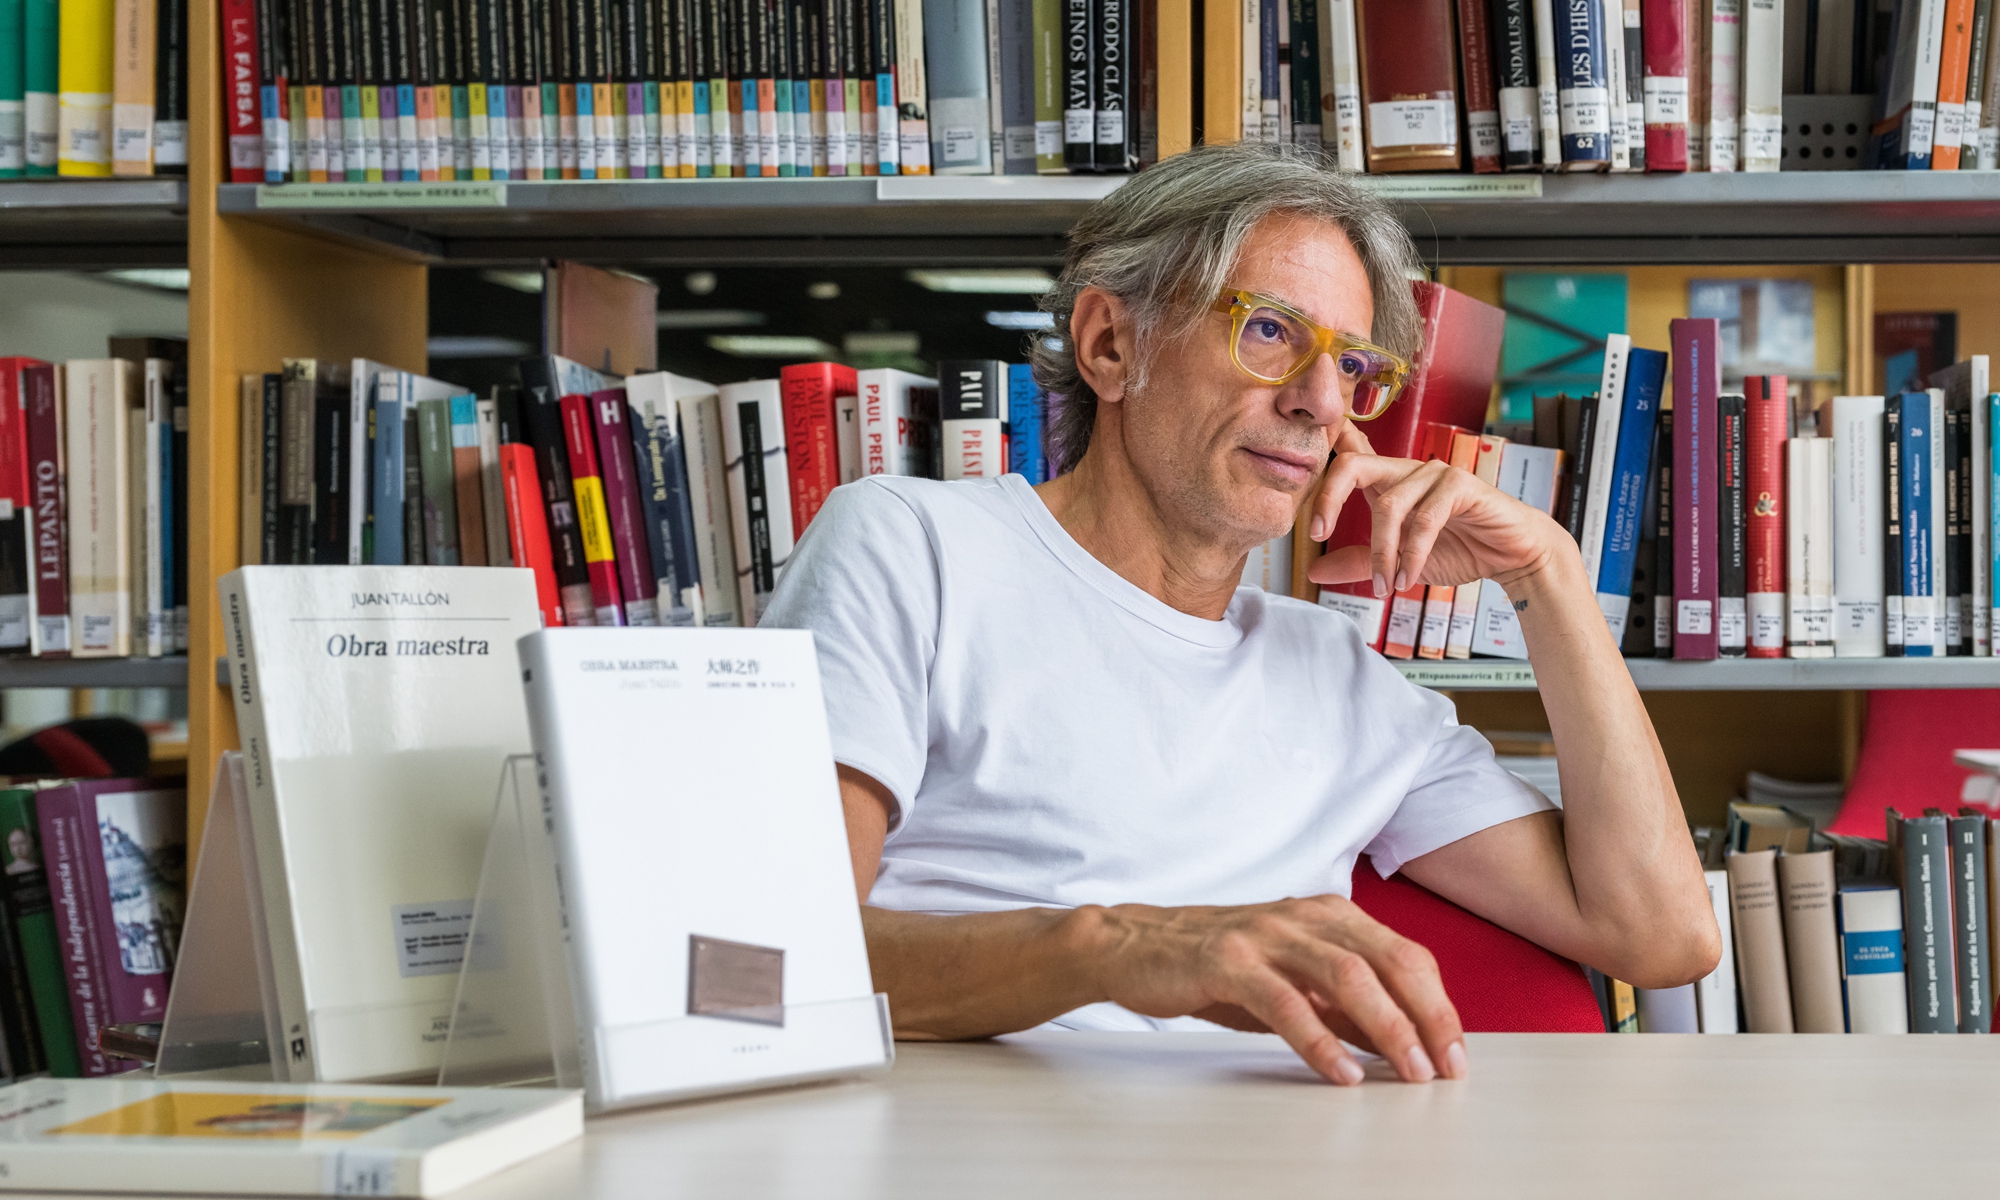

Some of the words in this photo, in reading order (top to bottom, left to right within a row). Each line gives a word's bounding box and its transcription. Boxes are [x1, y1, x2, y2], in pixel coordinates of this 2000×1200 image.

[232, 18, 248, 46] LA
[1507, 16, 1525, 88] ANDALUS
[233, 52, 254, 128] FARSA
[1577, 138, 1594, 149] 62
[1689, 339, 1699, 394] MESOAMÉRICA
[808, 377, 826, 425] PAUL
[959, 370, 984, 412] PAUL
[600, 400, 620, 425] H
[842, 409, 853, 422] T
[866, 383, 881, 427] PAUL
[1635, 400, 1650, 411] 25
[789, 378, 811, 471] PRESTON
[816, 425, 828, 438] La
[1013, 378, 1031, 471] PRESTON
[1691, 407, 1699, 433] PODER
[1725, 414, 1733, 450] GALEANO
[1731, 415, 1741, 442] LATINA
[1911, 428, 1923, 438] 26
[1691, 435, 1699, 449] DEL
[1857, 420, 1867, 458] AREQUIPA
[1725, 450, 1733, 487] EDUARDO
[1858, 459, 1866, 470] DE
[652, 486, 668, 502] De
[1616, 470, 1632, 505] durante
[1626, 474, 1642, 517] Colombia
[1732, 478, 1741, 489] DE
[1857, 471, 1867, 517] HISTÓRICOS
[36, 459, 60, 580] LEPANTO
[1732, 490, 1741, 526] ABIERTAS
[1611, 507, 1626, 543] Ecuador
[1624, 518, 1636, 541] Gran
[1691, 507, 1699, 558] FLORESCANO
[1909, 509, 1918, 538] Mundo
[1610, 544, 1621, 553] El
[1621, 542, 1631, 551] la
[1732, 527, 1741, 551] VENAS
[1802, 533, 1811, 557] Donghi
[1858, 518, 1867, 556] ESTUDIOS
[1733, 552, 1741, 568] LAS
[1910, 540, 1918, 563] Nuevo
[1691, 558, 1701, 594] ENRIQUE
[1909, 563, 1918, 576] del
[352, 592, 390, 608] JUAN
[391, 589, 450, 606] TALLÓN
[1341, 601, 1370, 611] Cervantes
[228, 593, 247, 659] maestra
[327, 634, 388, 658] Obra
[396, 635, 490, 656] maestra
[618, 659, 679, 671] MAESTRA
[706, 658, 761, 676] 大师之作
[1406, 672, 1416, 680] de
[1419, 672, 1492, 682] Hispanoamérica
[239, 663, 253, 705] Obra
[1920, 853, 1932, 882] Reales
[1964, 852, 1976, 880] Reales
[58, 863, 86, 962] Independencia
[1918, 882, 1934, 933] Comentarios
[1965, 880, 1978, 931] Comentarios
[1923, 933, 1935, 945] los
[1966, 932, 1978, 945] los
[1968, 945, 1980, 957] de
[1923, 946, 1936, 958] de
[75, 966, 89, 980] la
[1926, 958, 1939, 981] parte
[1970, 956, 1982, 979] parte
[78, 982, 93, 1000] de
[1925, 981, 1940, 1019] Segunda
[1969, 980, 1983, 1017] Segunda
[84, 1003, 99, 1050] Guerra
[91, 1056, 106, 1074] La
